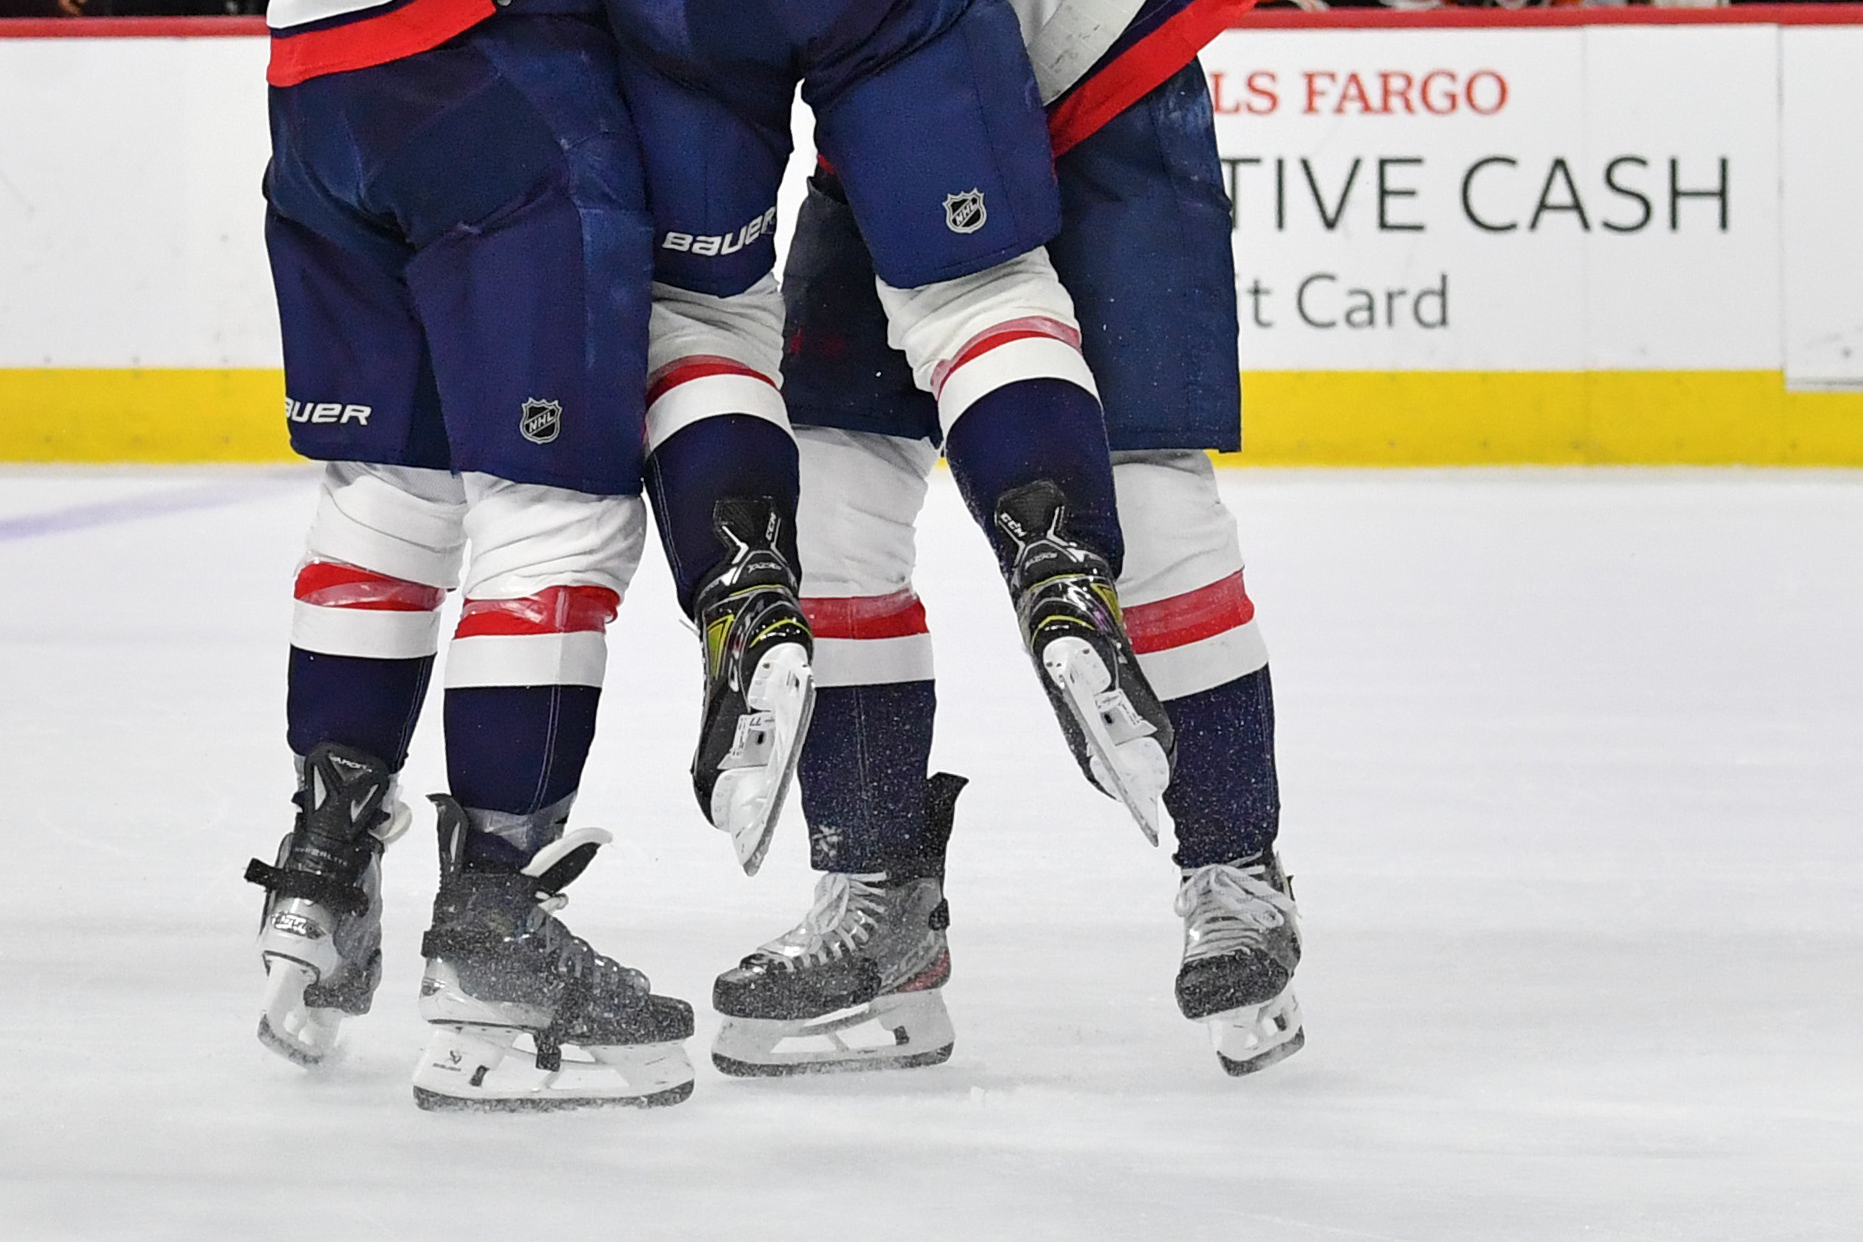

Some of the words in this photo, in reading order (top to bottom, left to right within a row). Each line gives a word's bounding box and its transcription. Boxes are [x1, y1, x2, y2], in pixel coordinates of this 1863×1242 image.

[1302, 70, 1510, 117] FARGO
[1459, 155, 1730, 234] CASH
[1296, 272, 1450, 330] Card
[528, 411, 558, 431] NHL
